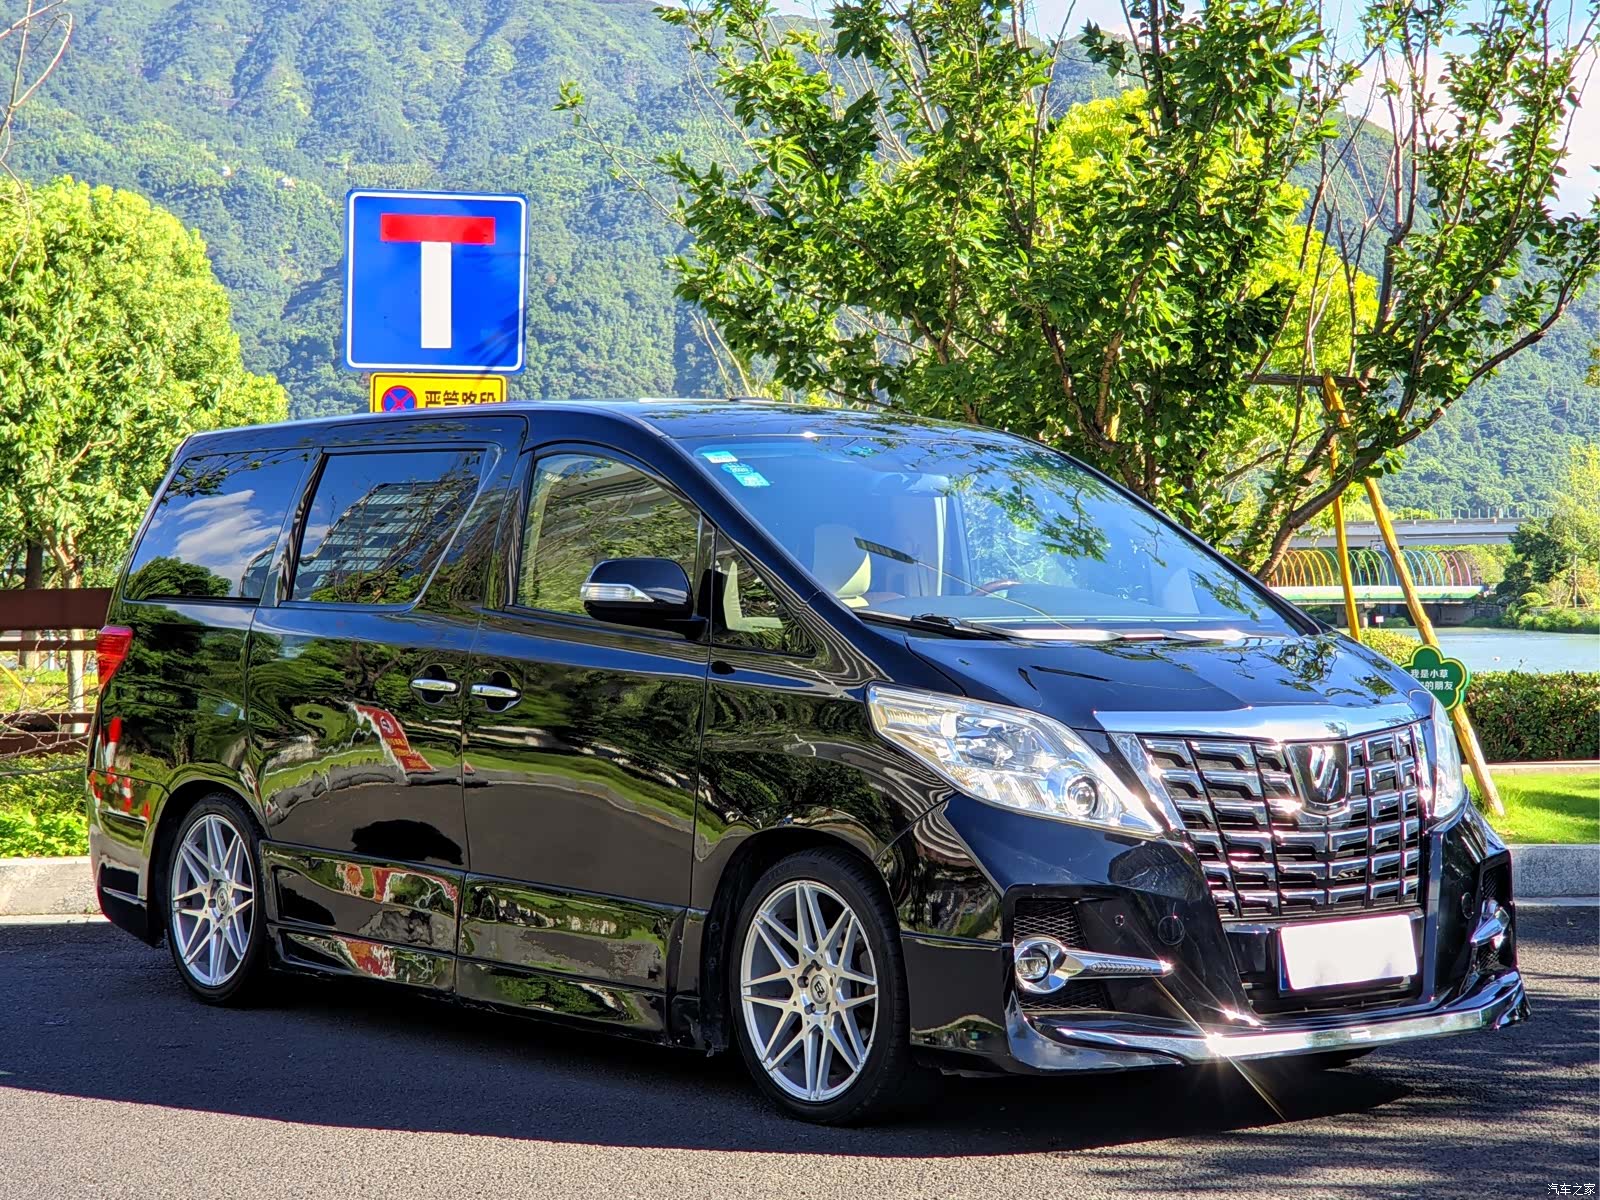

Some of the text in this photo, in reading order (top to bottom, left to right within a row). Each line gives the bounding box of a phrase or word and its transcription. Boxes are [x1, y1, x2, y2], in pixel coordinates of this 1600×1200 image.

[1410, 669, 1449, 679] 我是小草
[1421, 681, 1453, 691] 的朋友
